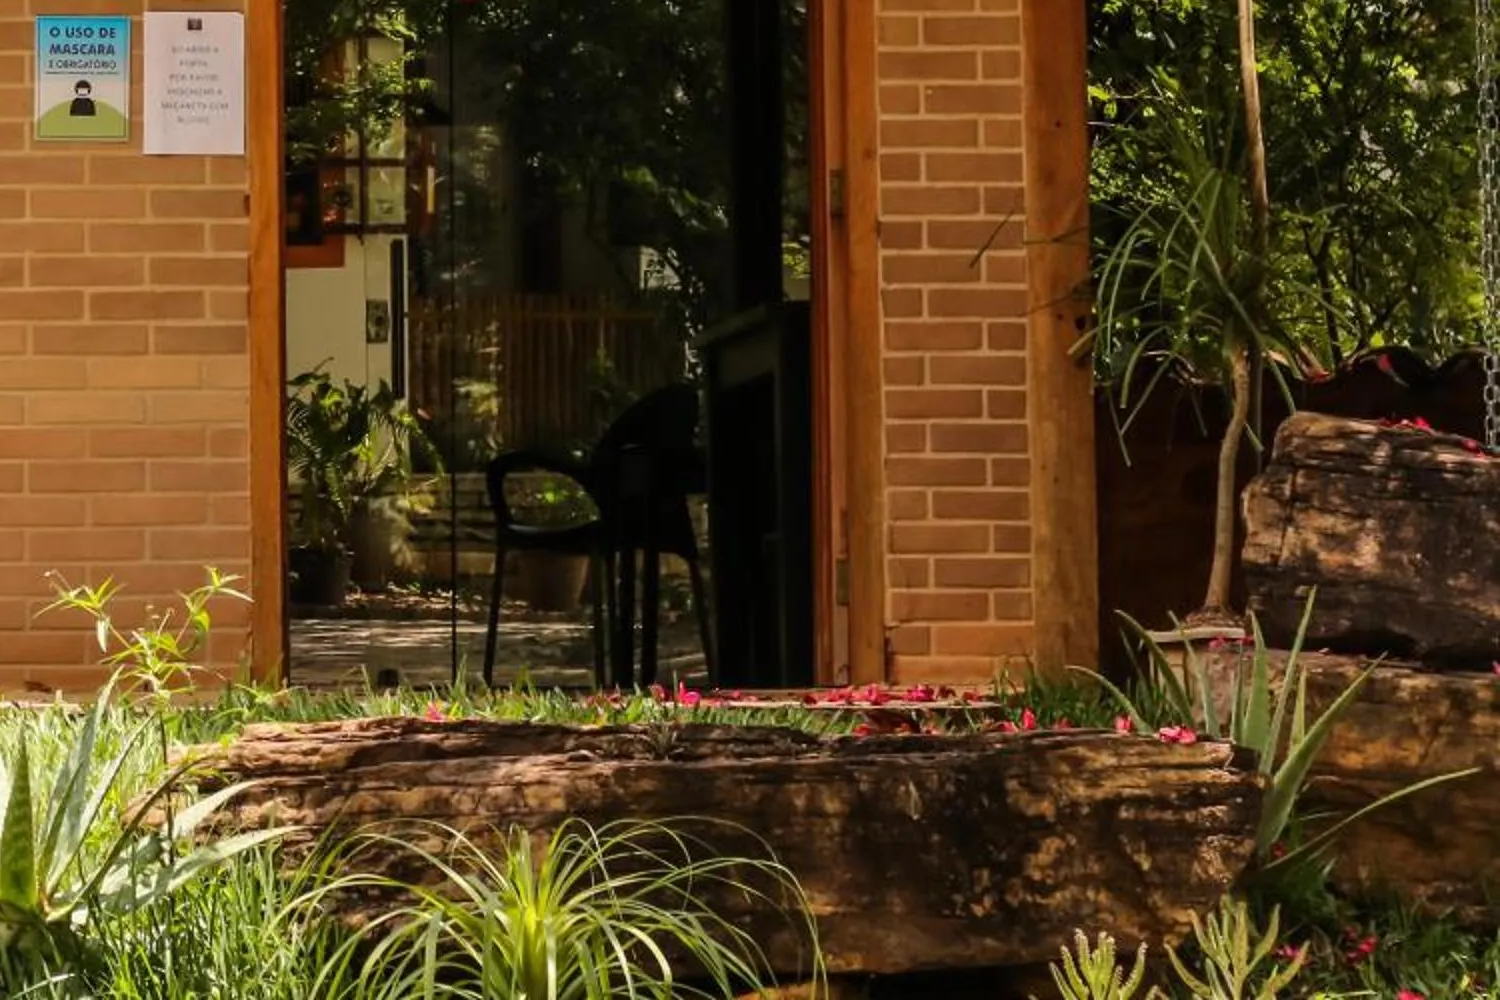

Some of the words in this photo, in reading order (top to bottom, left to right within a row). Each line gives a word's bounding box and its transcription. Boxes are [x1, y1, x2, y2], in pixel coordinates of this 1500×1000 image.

[49, 26, 61, 39] O
[65, 26, 94, 39] USO
[99, 27, 116, 39] DE
